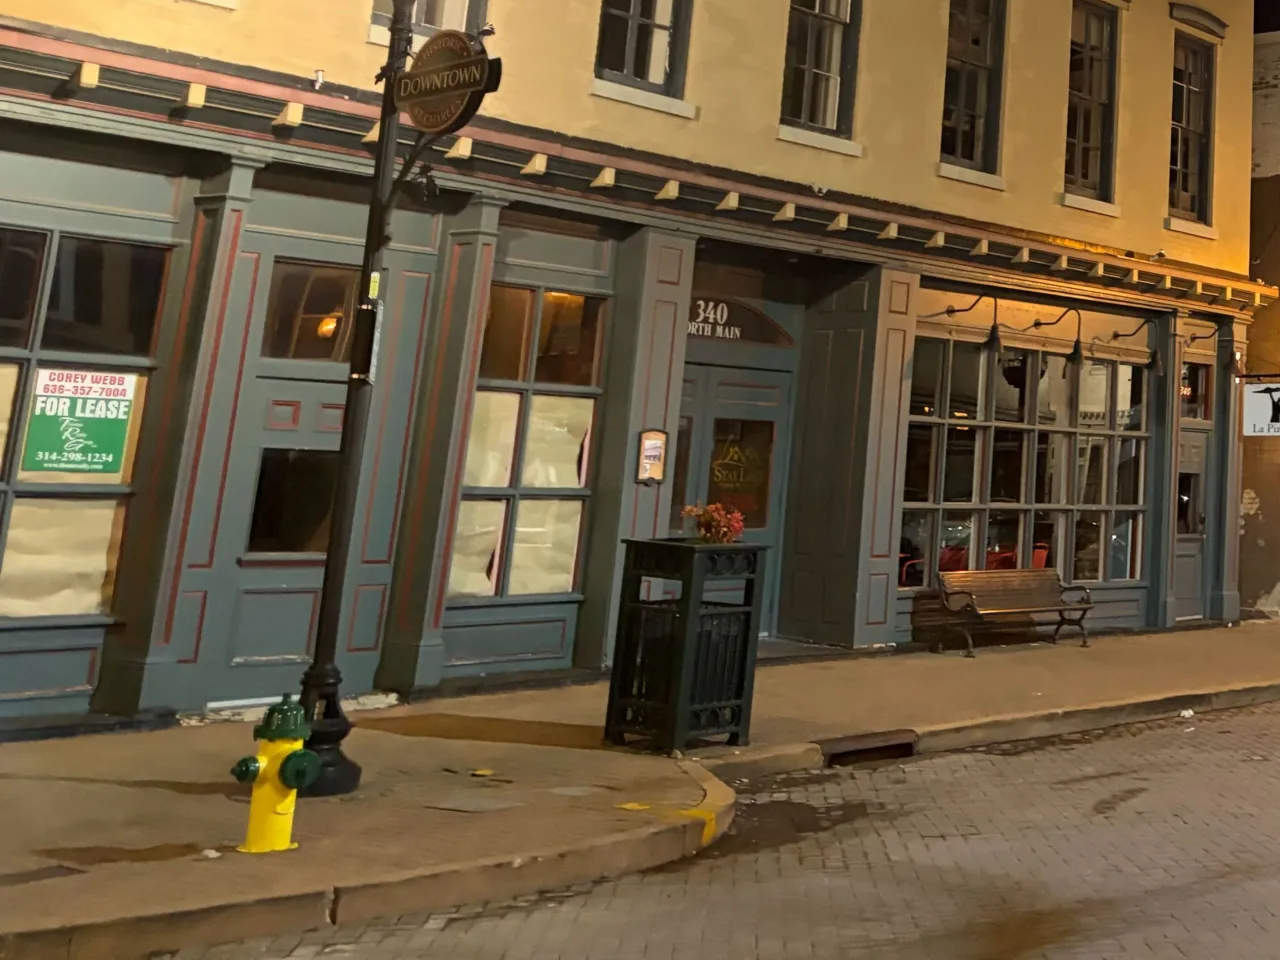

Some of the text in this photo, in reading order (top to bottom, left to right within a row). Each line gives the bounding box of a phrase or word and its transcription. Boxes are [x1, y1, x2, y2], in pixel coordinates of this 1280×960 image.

[401, 64, 480, 96] DOWNTOWN
[696, 300, 728, 324] 340
[688, 321, 742, 339] RTH MAIN
[48, 372, 125, 386] COREY WEBB
[43, 384, 127, 398] 636-357-7004
[35, 396, 130, 420] FOR LEASE
[1252, 423, 1264, 433] La
[35, 451, 114, 463] 314-298-1234
